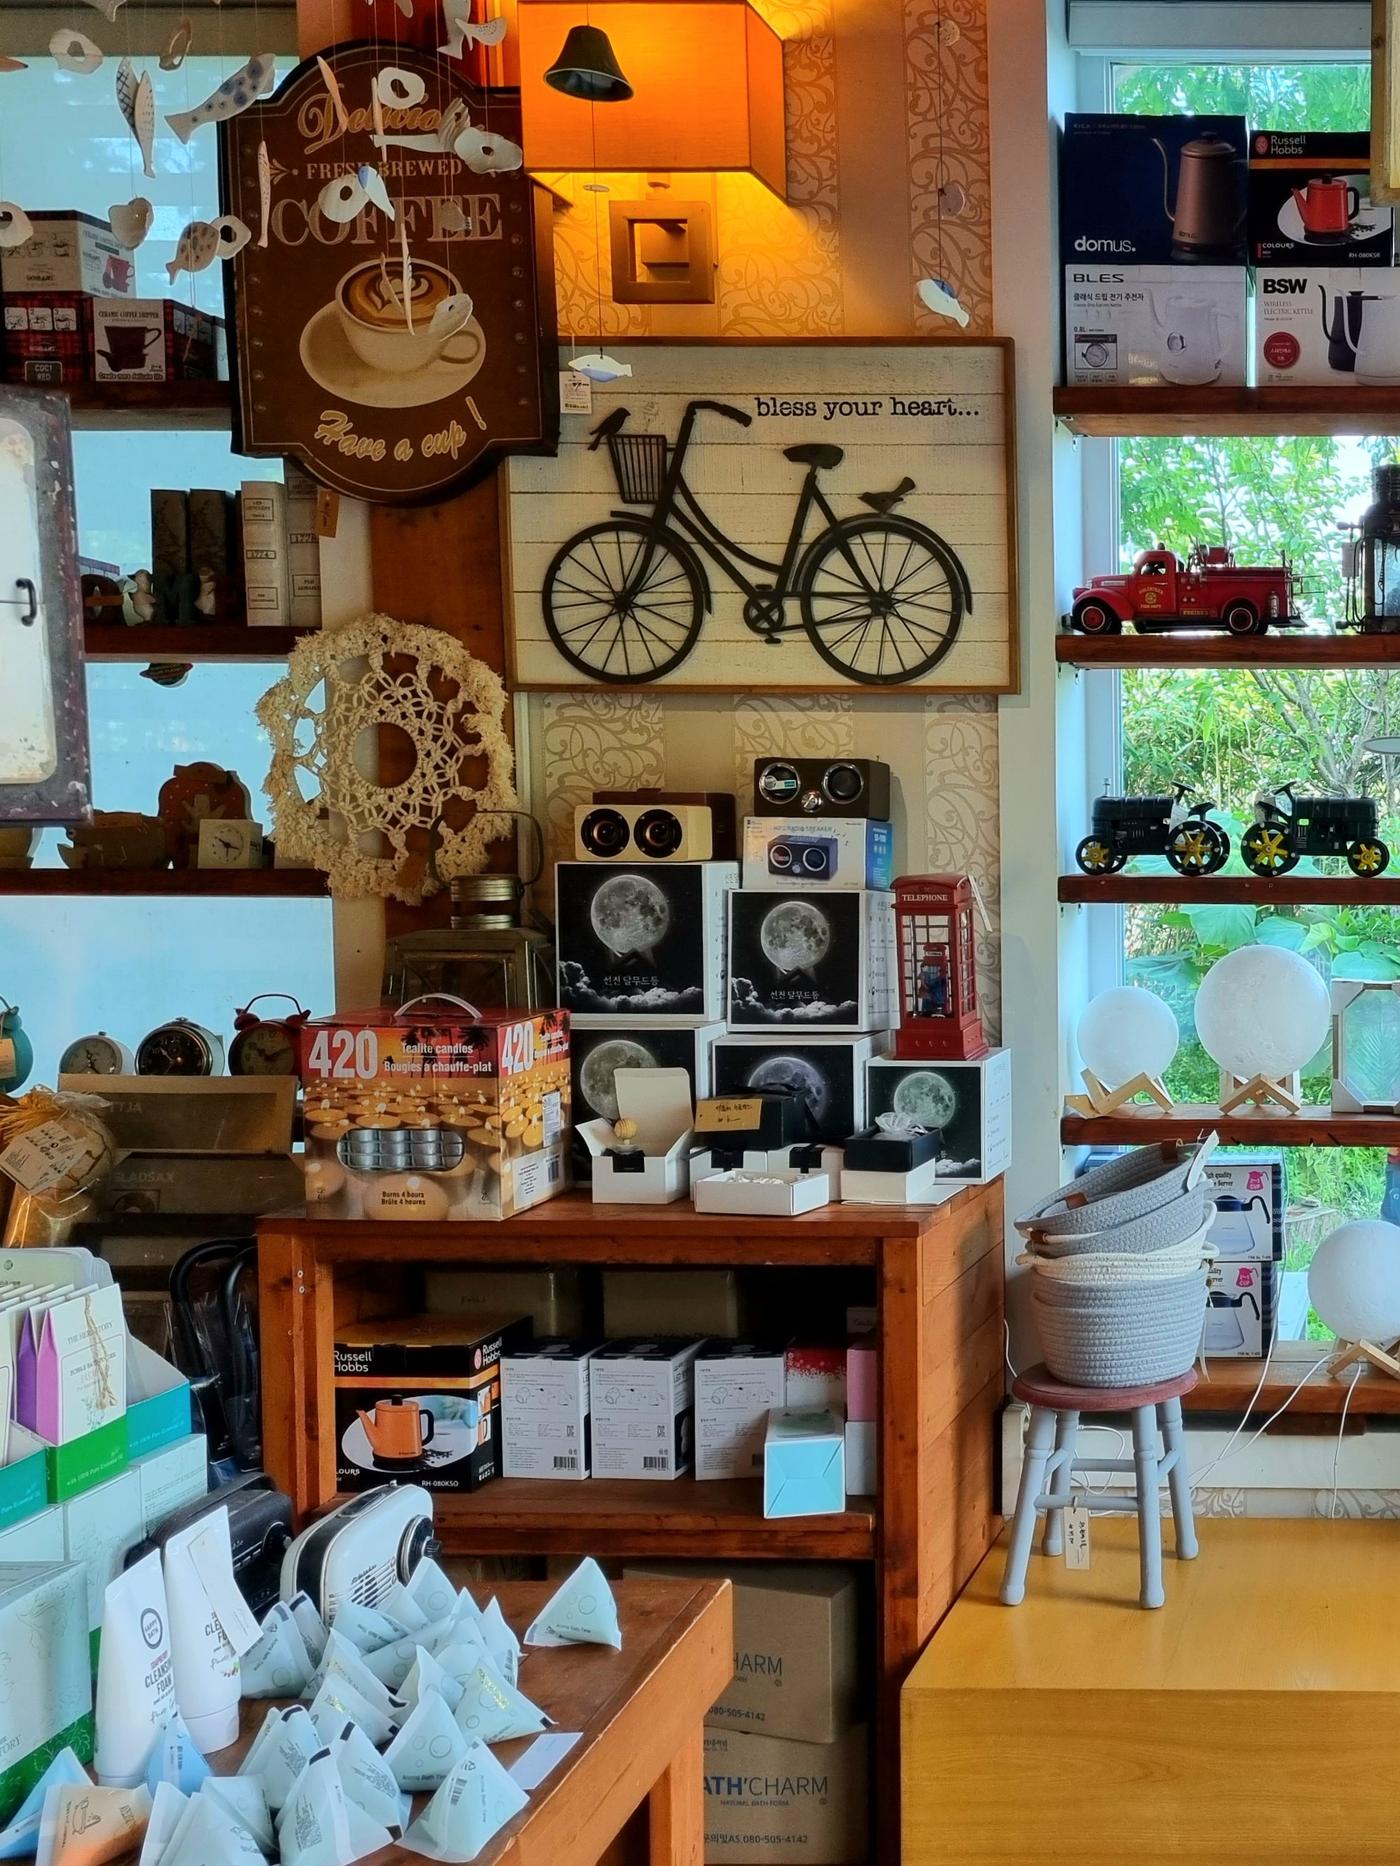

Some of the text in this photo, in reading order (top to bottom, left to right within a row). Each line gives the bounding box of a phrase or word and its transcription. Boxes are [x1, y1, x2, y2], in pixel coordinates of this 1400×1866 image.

[297, 91, 486, 155] Delicio
[1270, 135, 1307, 145] Russell
[1270, 145, 1304, 155] Hobbs
[377, 158, 462, 178] BREWED
[270, 192, 503, 246] COFFEE
[1074, 235, 1137, 253] domus.
[1262, 242, 1295, 250] COLOURS
[1073, 273, 1125, 283] BLES
[1263, 278, 1308, 295] BSW
[754, 396, 980, 421] bless your heart...
[314, 410, 387, 462] Have
[393, 438, 414, 462] a
[421, 420, 468, 460] cup
[901, 894, 949, 902] TELEPHONE
[308, 1030, 378, 1079] 420
[402, 1043, 474, 1054] Tealite candles
[501, 1021, 534, 1076] 420
[384, 1061, 423, 1074] Bougies
[432, 1061, 492, 1074] chauffe-plat
[405, 1198, 426, 1206] heures
[406, 1191, 425, 1199] hours
[482, 1336, 503, 1355] Russell
[334, 1351, 372, 1362] Russell
[144, 1618, 158, 1633] HAPPY
[147, 1627, 159, 1640] BATH
